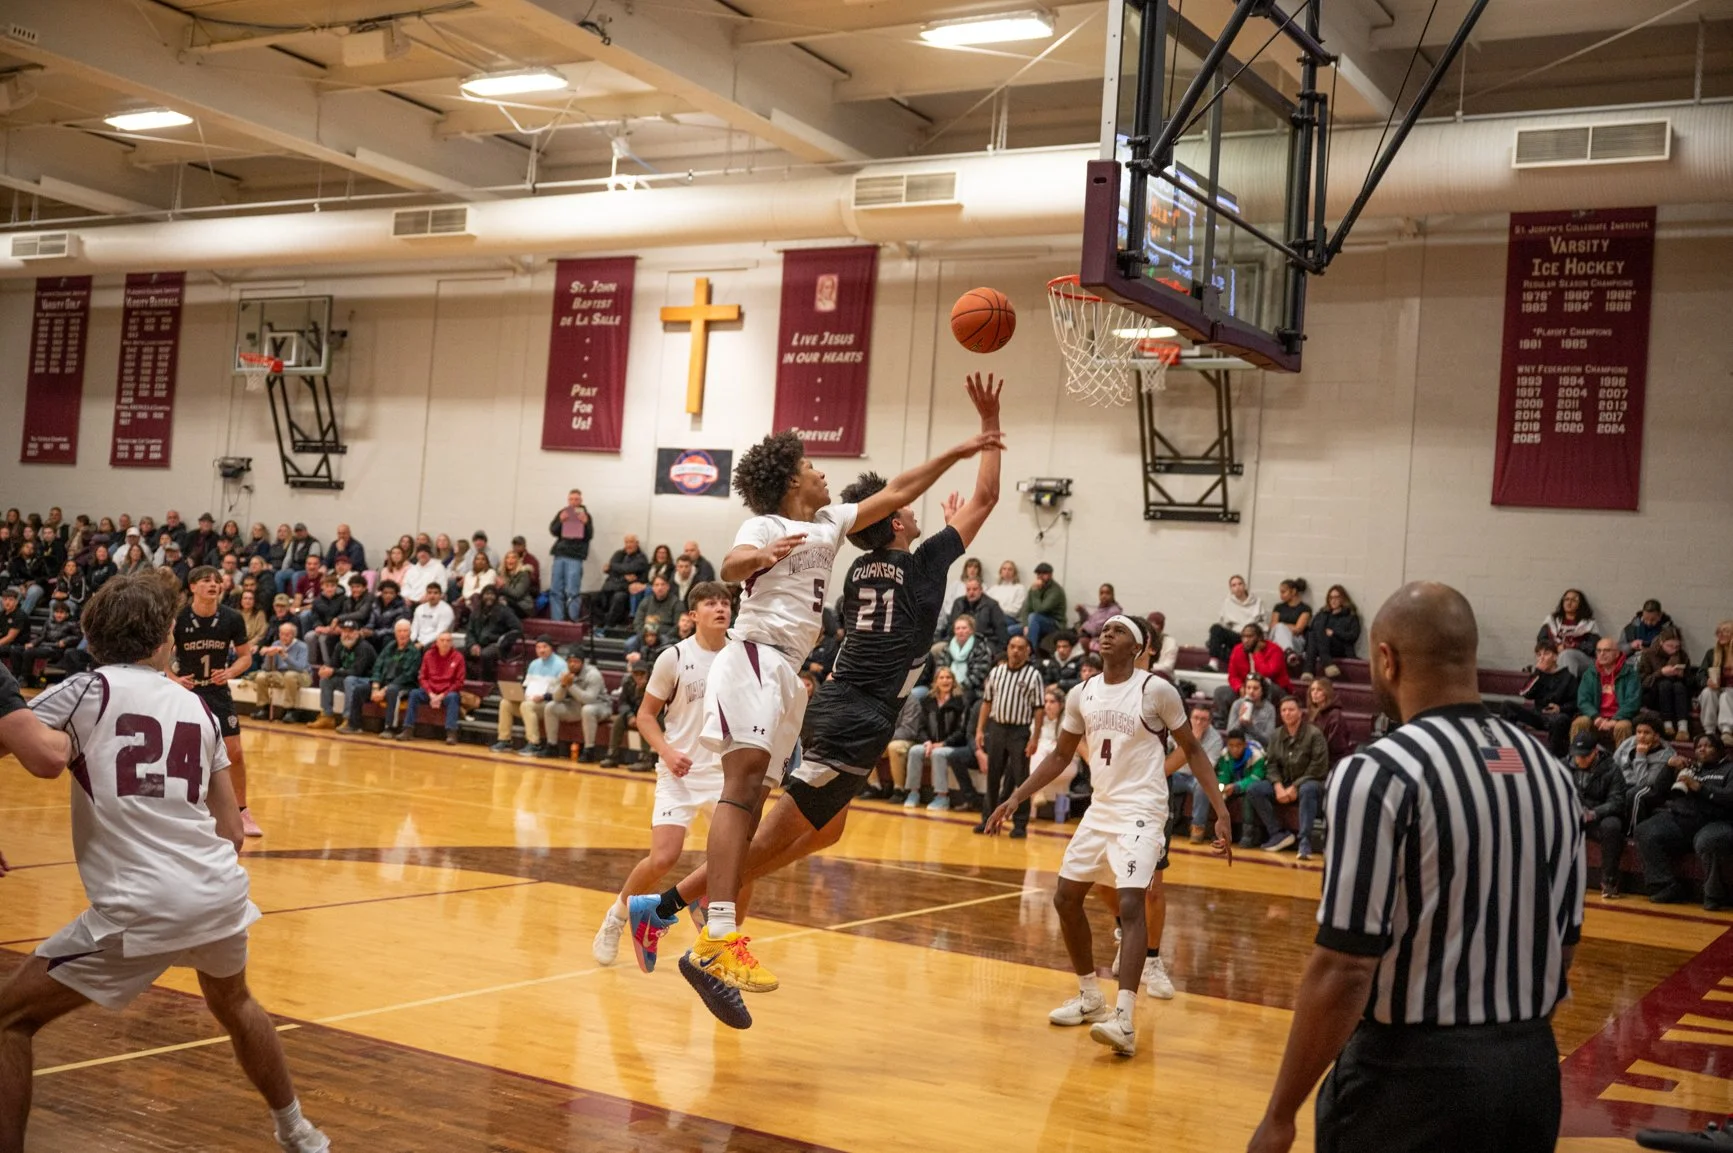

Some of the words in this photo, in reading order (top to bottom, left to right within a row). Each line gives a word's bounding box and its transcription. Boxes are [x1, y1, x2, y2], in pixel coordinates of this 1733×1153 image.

[1550, 236, 1610, 254] VARSITY
[1531, 258, 1560, 276] ICE
[1564, 258, 1625, 276] HOCKEY
[590, 279, 618, 293] JOHN
[572, 297, 612, 310] BAPTIST
[560, 317, 572, 327] DE
[575, 313, 589, 326] LA
[591, 312, 621, 326] SALLE
[791, 333, 818, 346] LIVE
[820, 332, 854, 345] JESUS
[782, 352, 794, 364] IN
[796, 352, 820, 363] OUR
[822, 351, 864, 363] HEARTS
[570, 384, 598, 397] PRAY
[1599, 388, 1629, 399] 2007
[572, 401, 593, 413] FOR
[571, 416, 592, 430] US!
[852, 562, 904, 585] QUAKERS
[812, 578, 825, 614] 5
[855, 587, 895, 633] 21
[183, 640, 226, 650] ORCHARD
[200, 654, 211, 678] 1
[115, 713, 203, 805] 24
[1100, 738, 1112, 766] 4
